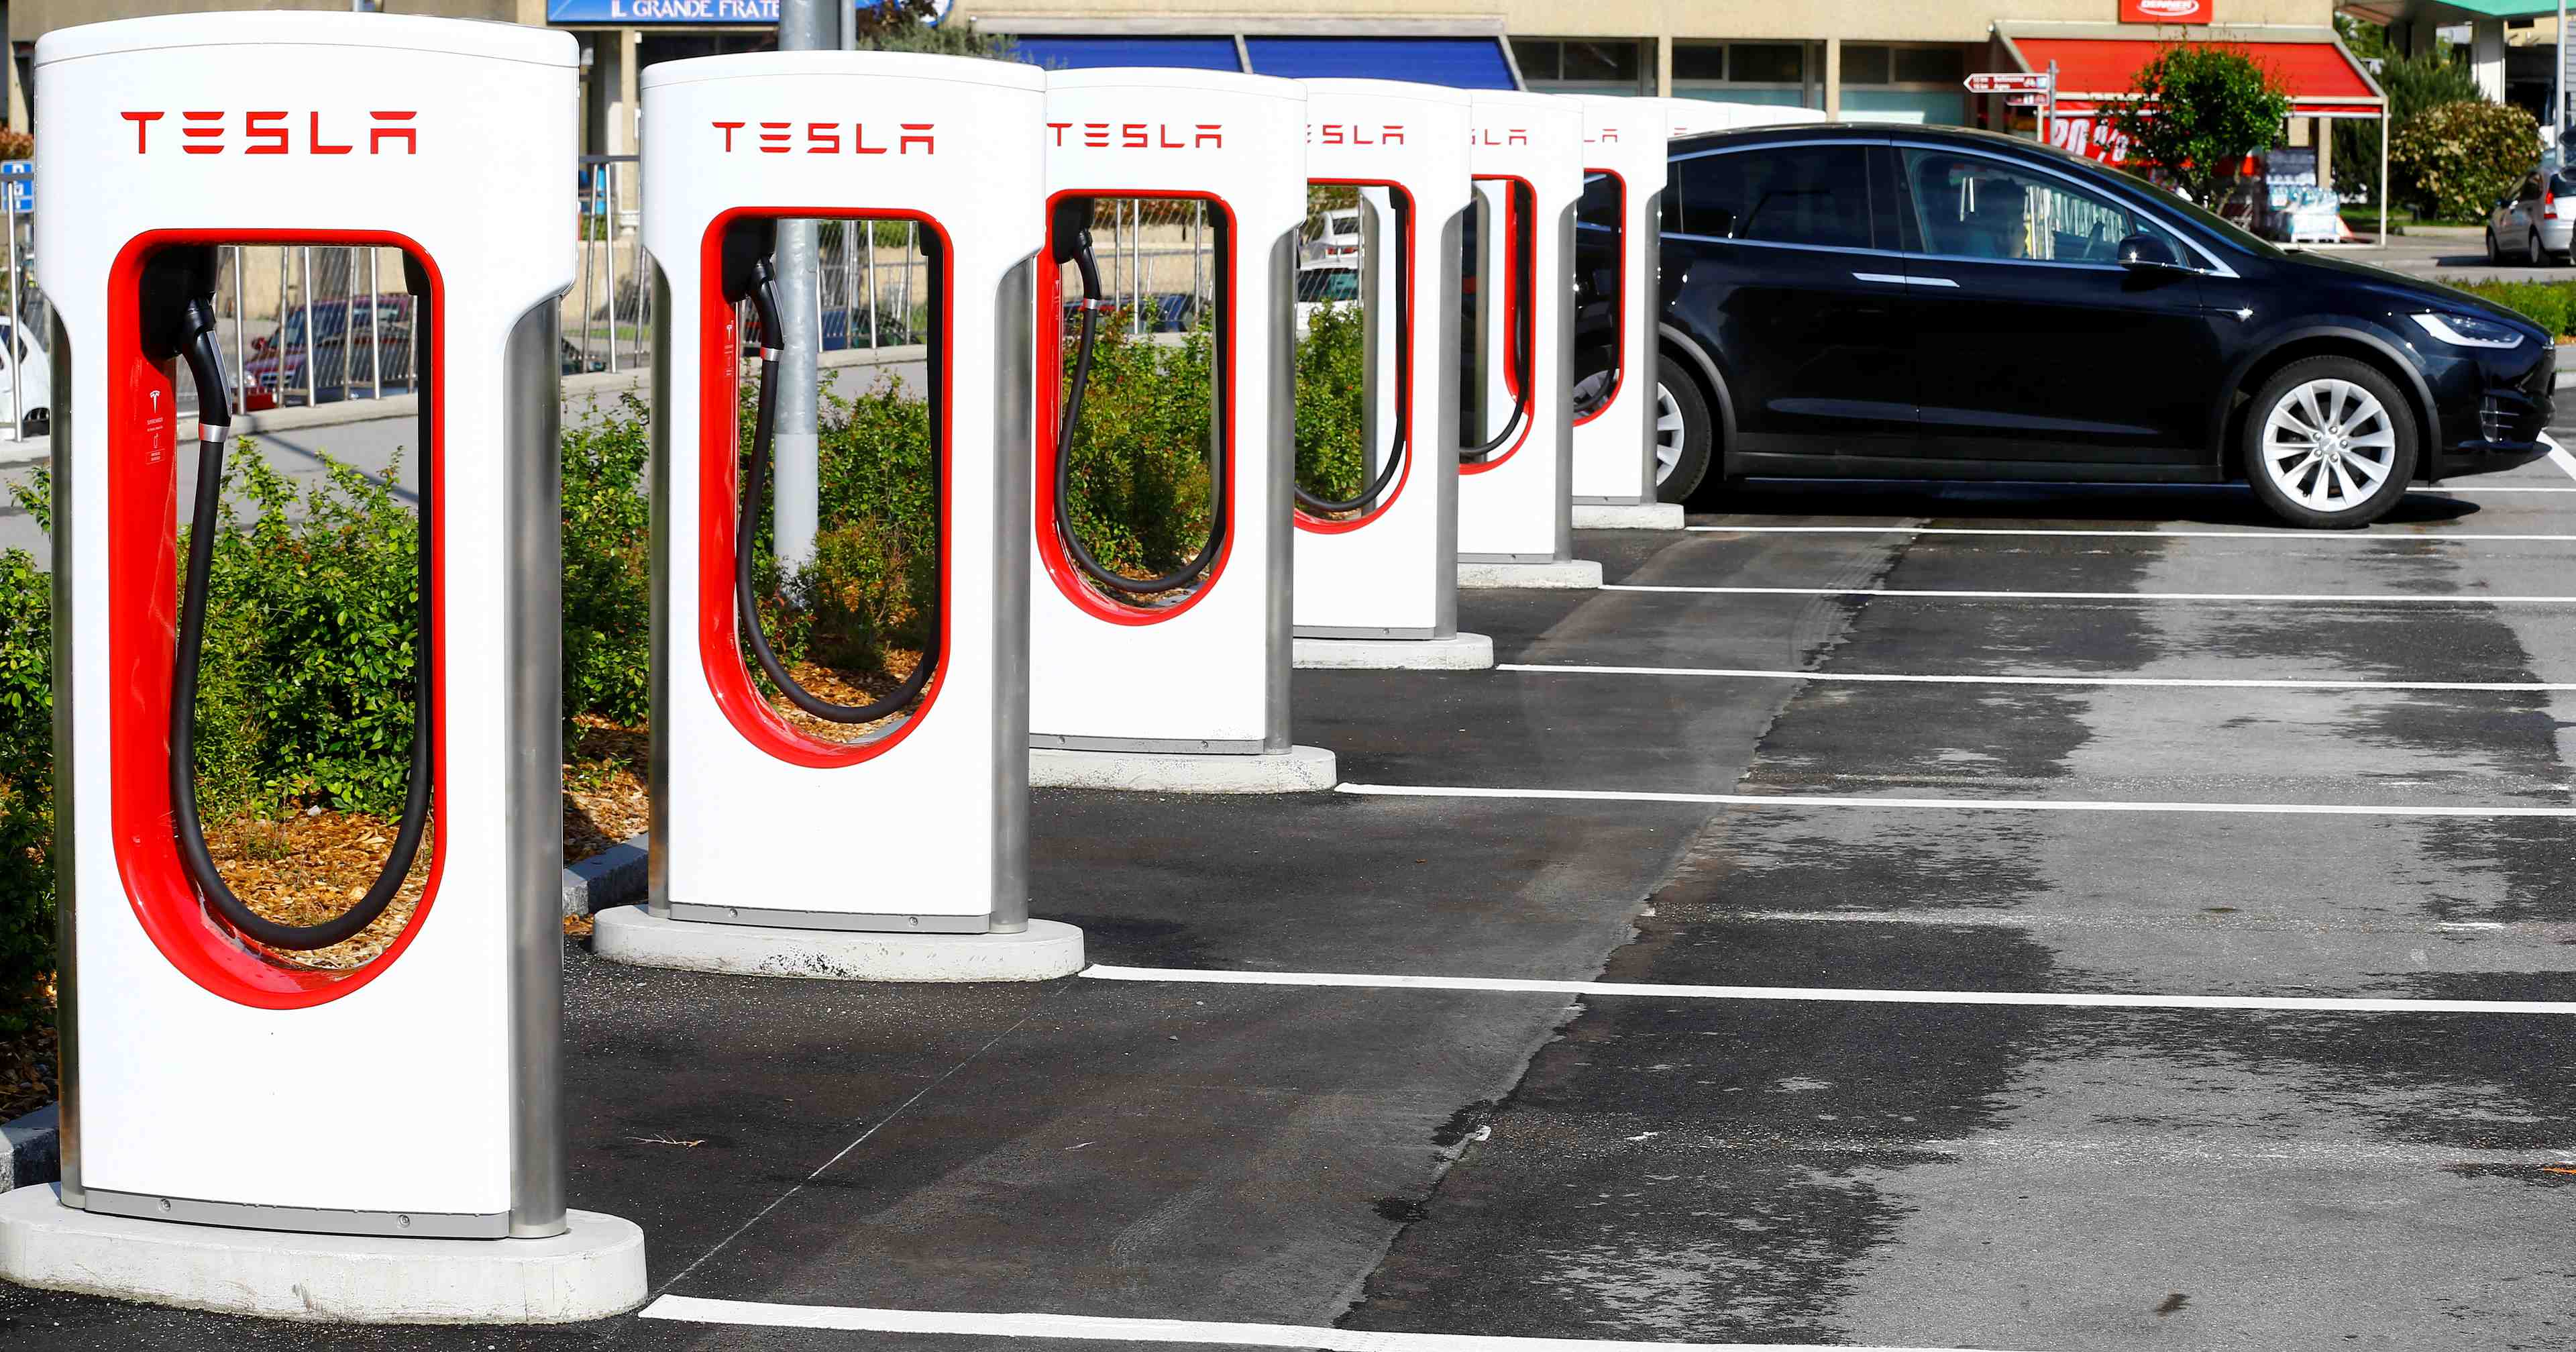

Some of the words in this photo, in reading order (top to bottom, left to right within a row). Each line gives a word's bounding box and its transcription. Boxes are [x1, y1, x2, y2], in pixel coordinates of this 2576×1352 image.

[612, 0, 627, 17] IL
[633, 0, 714, 18] GRANDE
[121, 111, 417, 154] TESLA
[712, 122, 934, 154] TESLA
[1046, 123, 1222, 148] TESLA
[1307, 124, 1404, 145] SLA
[1472, 129, 1527, 145] LA
